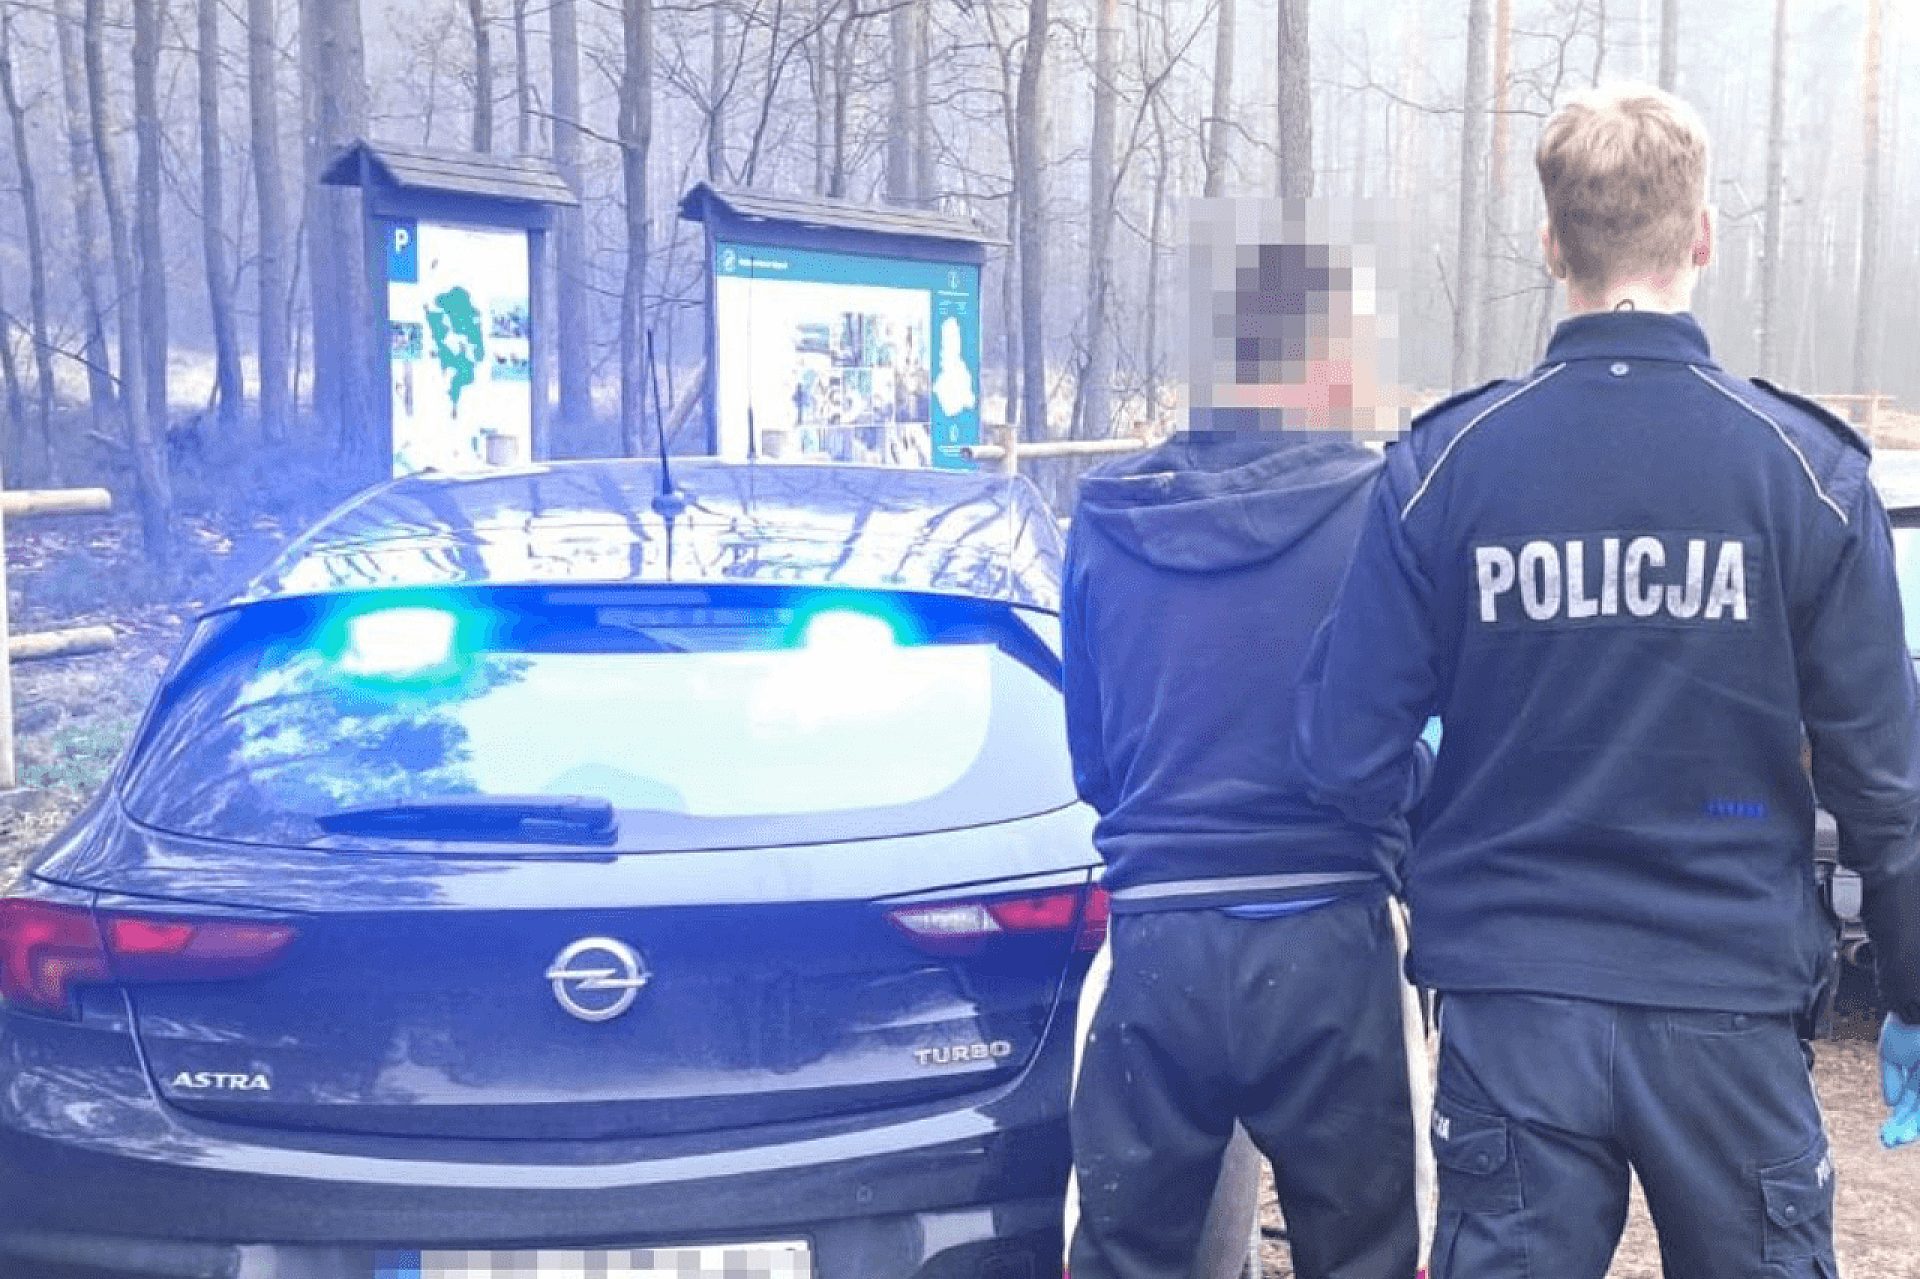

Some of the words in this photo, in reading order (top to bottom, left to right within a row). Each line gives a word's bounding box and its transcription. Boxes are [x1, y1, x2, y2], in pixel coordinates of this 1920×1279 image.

[395, 228, 409, 253] P
[1475, 536, 1748, 622] POLICJA
[914, 1041, 1012, 1065] TURBO
[172, 1071, 271, 1091] ASTRA
